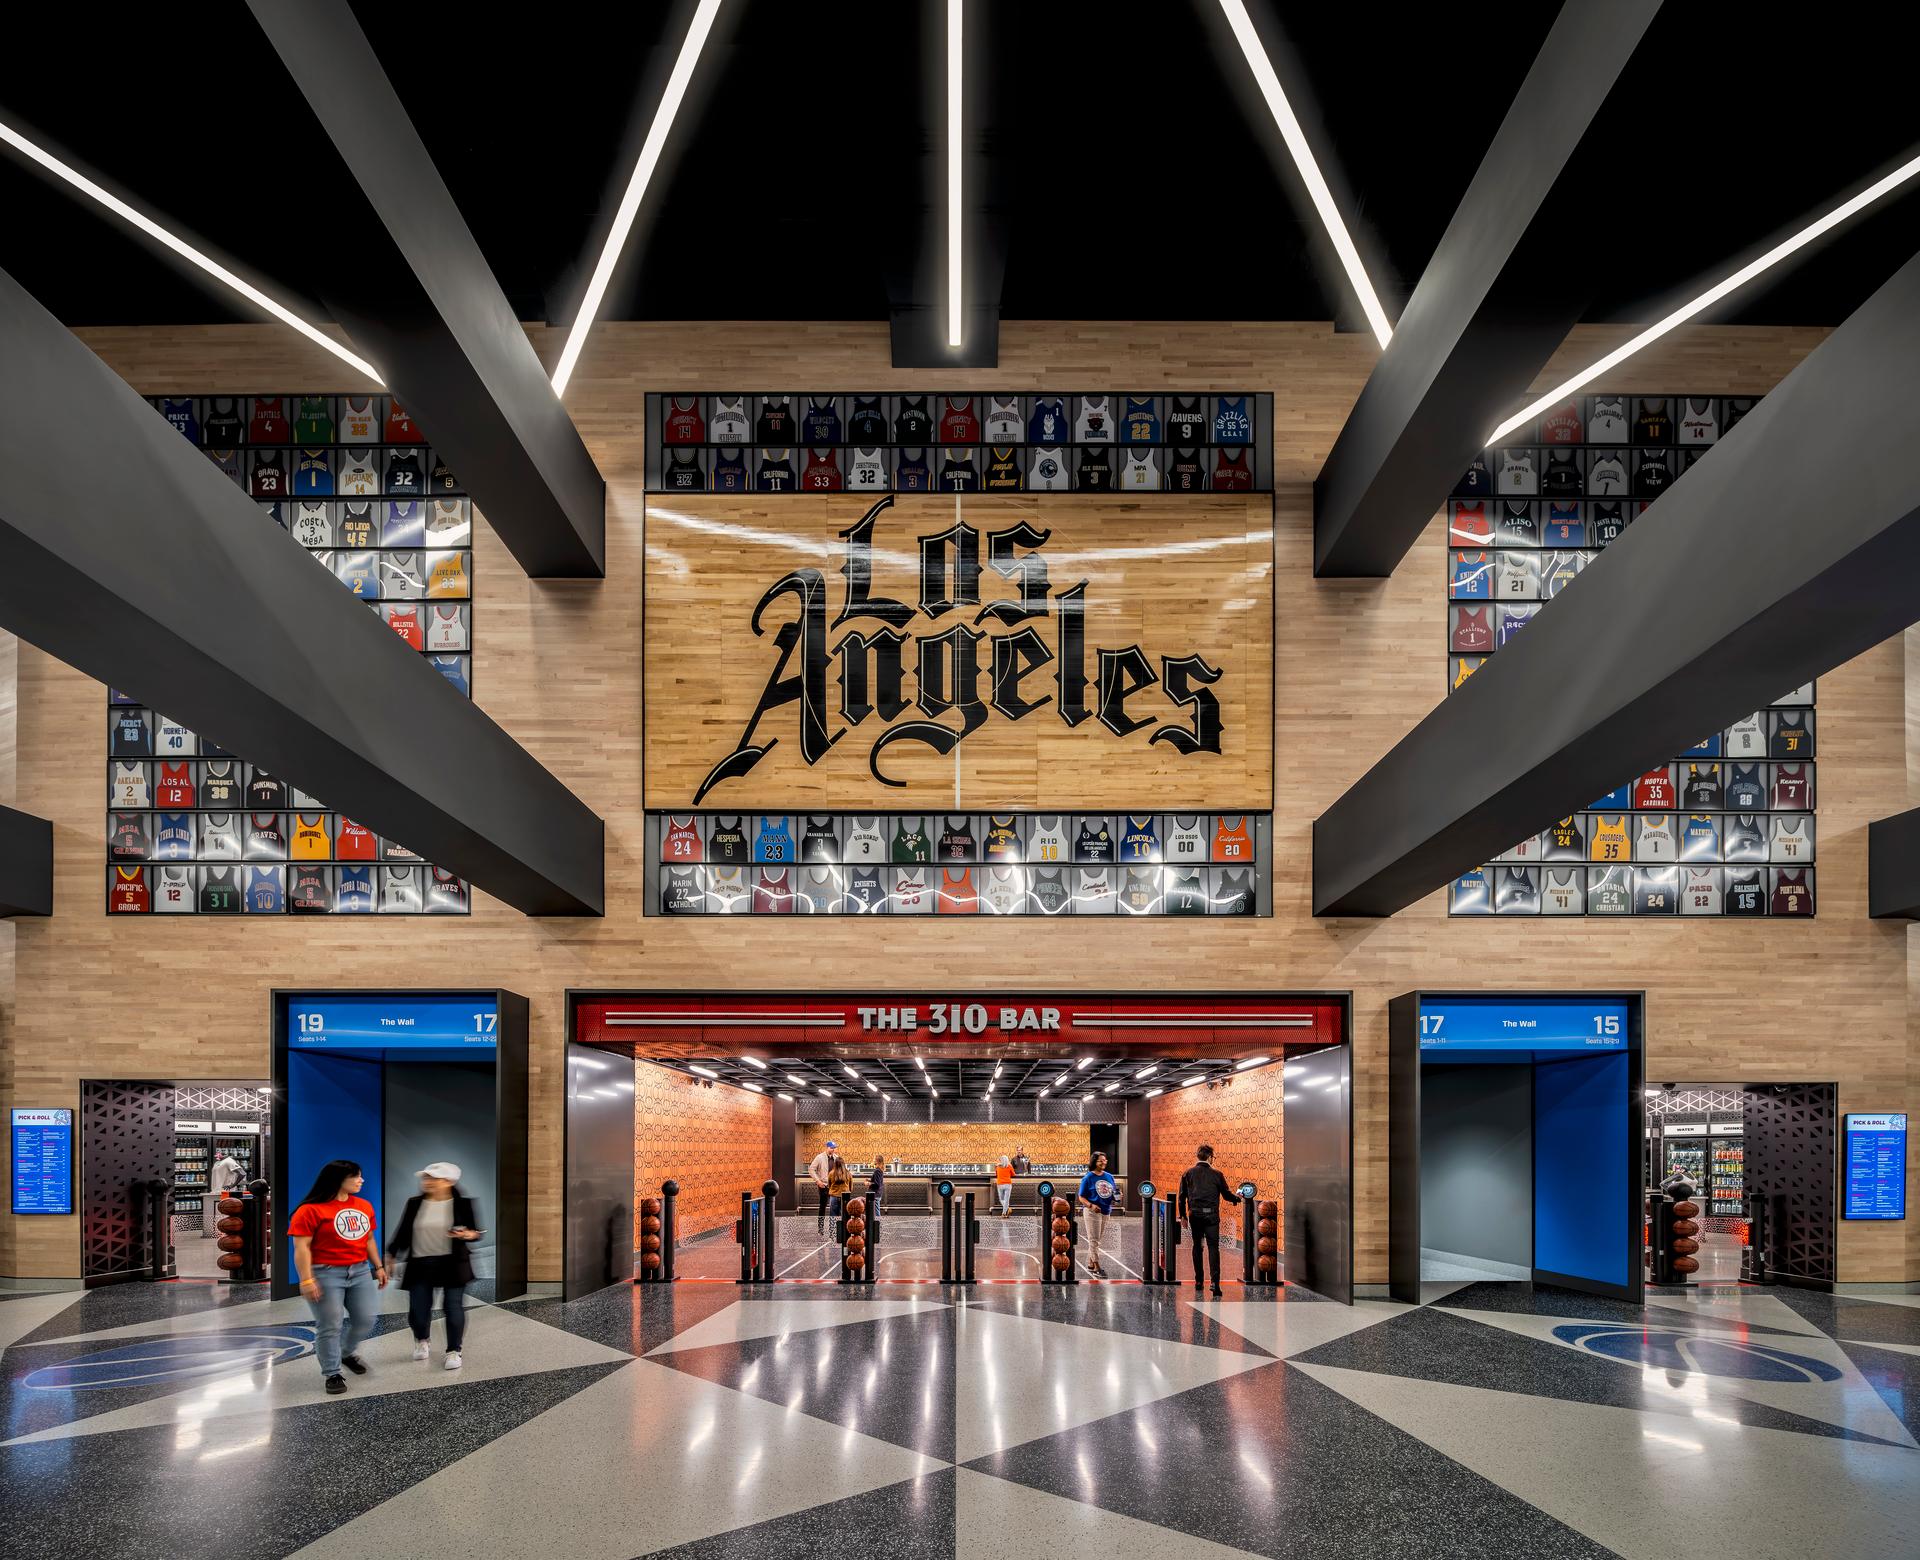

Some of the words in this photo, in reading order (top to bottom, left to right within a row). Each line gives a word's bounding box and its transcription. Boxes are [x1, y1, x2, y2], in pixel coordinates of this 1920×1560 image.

[168, 413, 189, 421] PRICE
[1170, 413, 1203, 423] RAVENS
[1216, 411, 1248, 430] GRIZZLIES
[401, 422, 408, 432] 4
[910, 421, 916, 431] 2
[1182, 424, 1192, 439] 9
[345, 472, 373, 485] JAGUARS
[394, 472, 413, 486] 32
[814, 476, 829, 487] 33
[860, 470, 875, 483] 32
[261, 478, 277, 490] 23
[771, 478, 782, 491] 11
[954, 479, 964, 491] 11
[1504, 518, 1532, 528] ALISO
[309, 527, 315, 537] 3
[1603, 525, 1617, 539] 10
[831, 494, 1053, 632] Los
[1466, 580, 1478, 593] 12
[1511, 580, 1524, 592] 21
[1470, 632, 1475, 643] 1
[692, 566, 1226, 807] Angeles
[120, 719, 142, 728] MERCY
[169, 736, 183, 748] 40
[1786, 738, 1798, 751] 31
[126, 786, 134, 797] 2
[169, 789, 182, 802] 12
[1650, 786, 1662, 799] 35
[1789, 786, 1796, 798] 7
[716, 834, 741, 843] HESPERIA
[1127, 833, 1155, 844] LINCOLN
[1553, 829, 1576, 837] EAGLES
[1557, 836, 1571, 847] 24
[674, 841, 692, 856] 24
[764, 845, 784, 860] 23
[862, 843, 869, 854] 3
[1041, 845, 1058, 861] 10
[1090, 850, 1099, 858] 22
[1225, 844, 1240, 856] 20
[1604, 844, 1619, 858] 35
[1785, 844, 1797, 856] 41
[916, 851, 925, 862] 11
[116, 883, 143, 892] PACIFIC
[432, 884, 459, 893] BRAVES
[672, 880, 692, 888] MARIN
[854, 880, 877, 888] KNIGHTS
[125, 892, 134, 903] 5
[167, 890, 181, 901] 12
[210, 893, 229, 909] 31
[255, 892, 274, 909] 10
[861, 888, 869, 902] 3
[1603, 892, 1618, 903] 24
[1647, 893, 1665, 907] 24
[1695, 895, 1709, 907] 22
[1738, 893, 1756, 909] 15
[118, 903, 141, 912] GROVE
[1556, 895, 1568, 908] 41
[1787, 895, 1798, 912] 2
[1596, 904, 1625, 912] CHRISTIAN
[298, 1014, 324, 1033] 19
[381, 1018, 396, 1026] The
[397, 1018, 414, 1026] Wall
[473, 1013, 497, 1033] 17
[858, 1008, 917, 1031] THE
[928, 1004, 988, 1034] 310
[999, 1008, 1061, 1031] BAR
[1419, 1015, 1444, 1034] 17
[1502, 1020, 1518, 1028] The
[1519, 1020, 1536, 1028] Wall
[1593, 1016, 1620, 1034] 15
